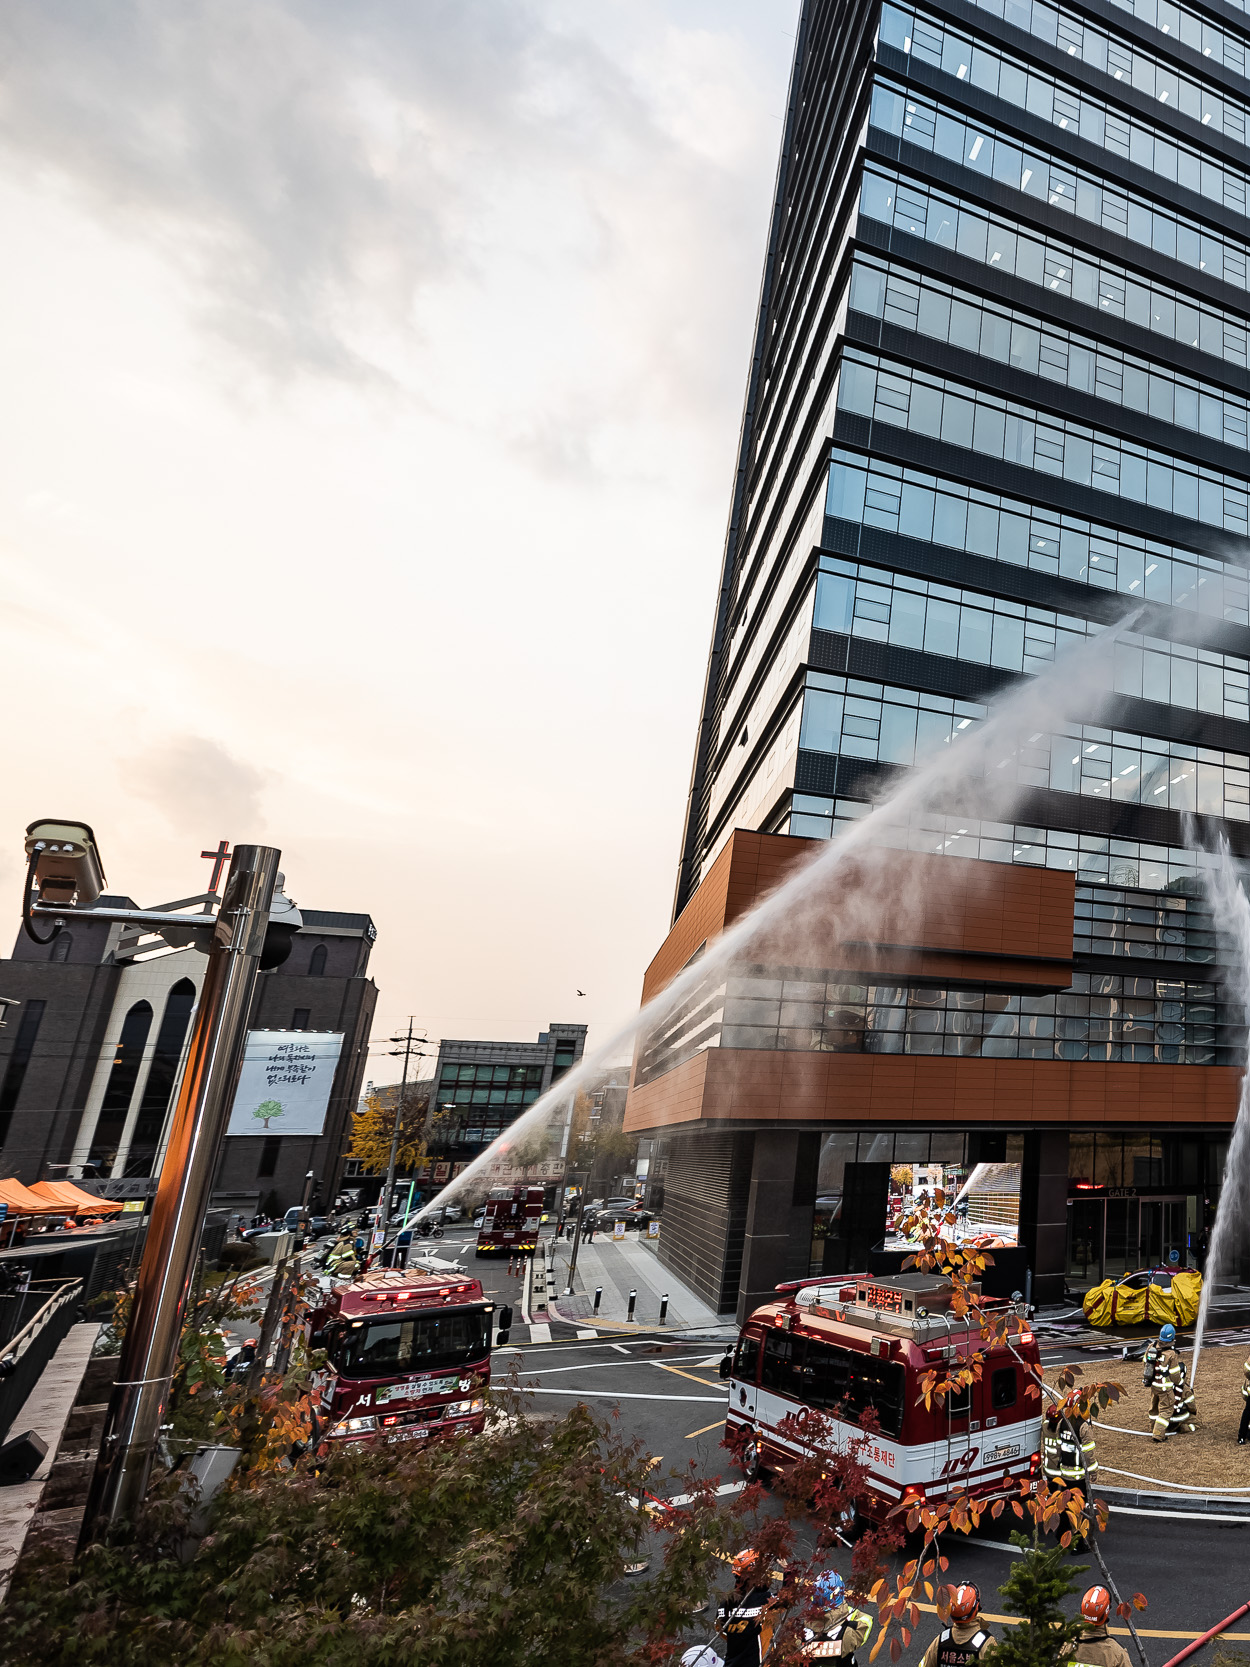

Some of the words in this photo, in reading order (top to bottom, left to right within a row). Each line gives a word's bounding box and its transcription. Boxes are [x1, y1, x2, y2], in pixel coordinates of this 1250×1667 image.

[1108, 1188, 1130, 1197] GATE
[1131, 1188, 1137, 1197] 2
[939, 1447, 980, 1478] 119
